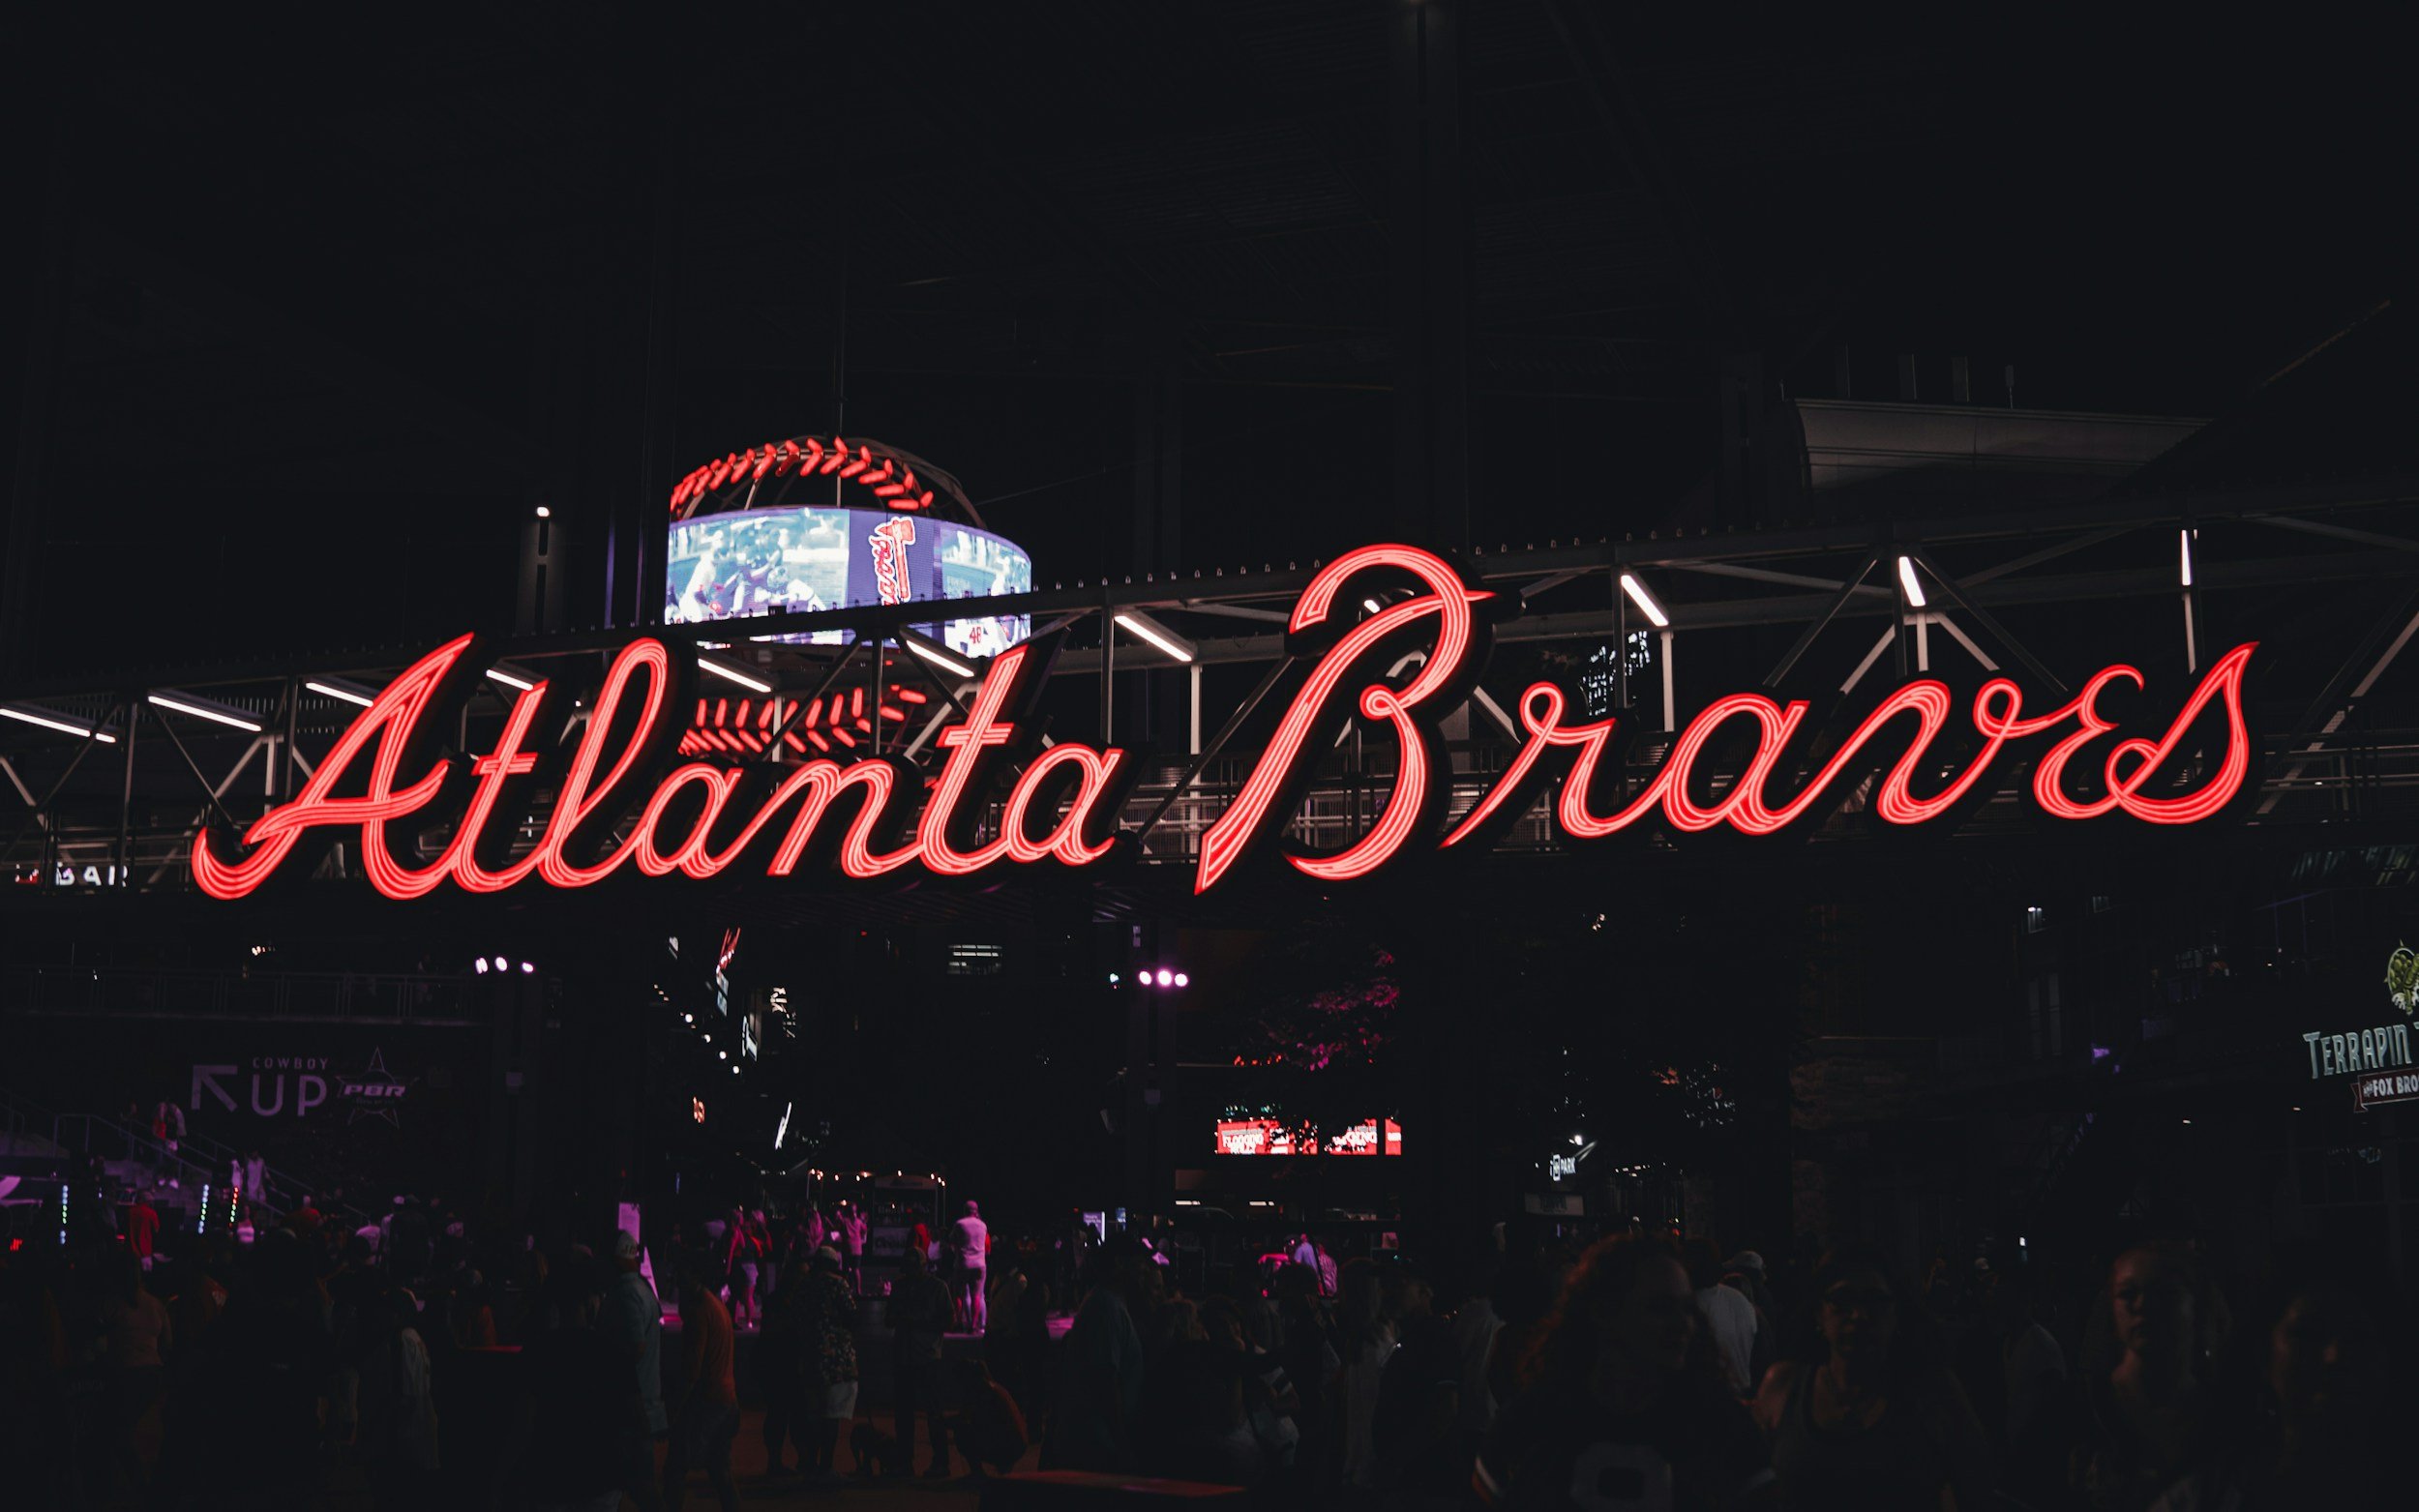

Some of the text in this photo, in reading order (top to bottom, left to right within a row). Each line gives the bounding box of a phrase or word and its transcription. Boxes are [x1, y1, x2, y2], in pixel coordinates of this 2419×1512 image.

[191, 543, 2259, 901] Atlanta Braves
[252, 1056, 329, 1070] COWBOY
[2303, 1023, 2412, 1080] TERRAPIN
[251, 1074, 327, 1117] UP
[343, 1084, 405, 1097] PBR
[2373, 1078, 2395, 1097] FOX
[2396, 1074, 2419, 1094] BRO
